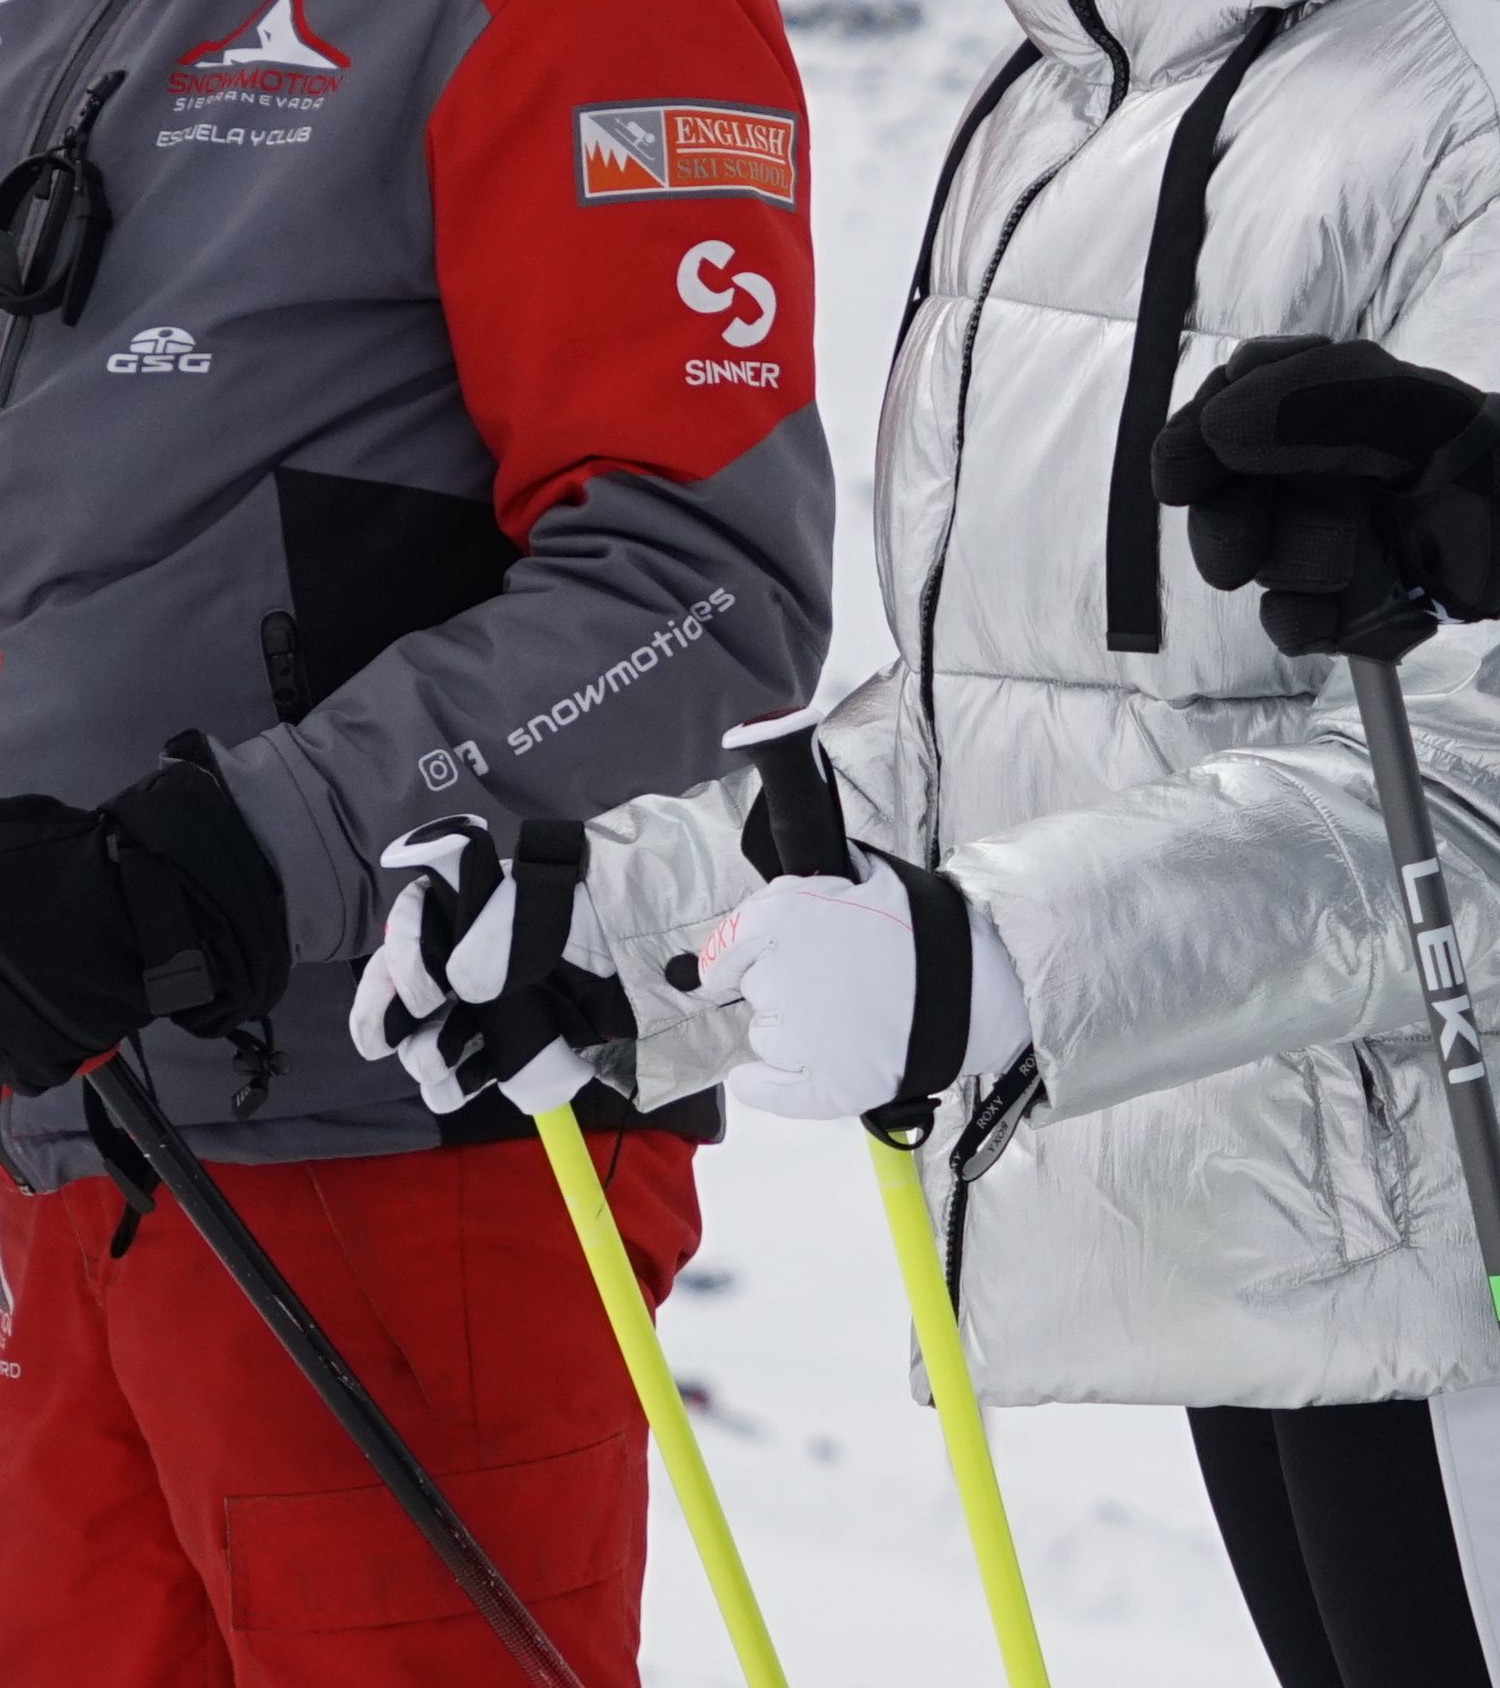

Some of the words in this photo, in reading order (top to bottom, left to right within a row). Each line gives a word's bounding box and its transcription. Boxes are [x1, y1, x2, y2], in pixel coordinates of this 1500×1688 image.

[168, 69, 344, 95] SNOWMOTION
[250, 130, 265, 147] Y
[265, 126, 312, 146] CLUB
[674, 116, 786, 156] ENGLISH
[677, 159, 718, 180] SKI
[724, 160, 790, 190] SCHOOL
[106, 353, 212, 373] GSG
[685, 359, 780, 388] SINNER
[1402, 857, 1485, 1085] LEKI
[975, 1095, 1004, 1130] ROXY
